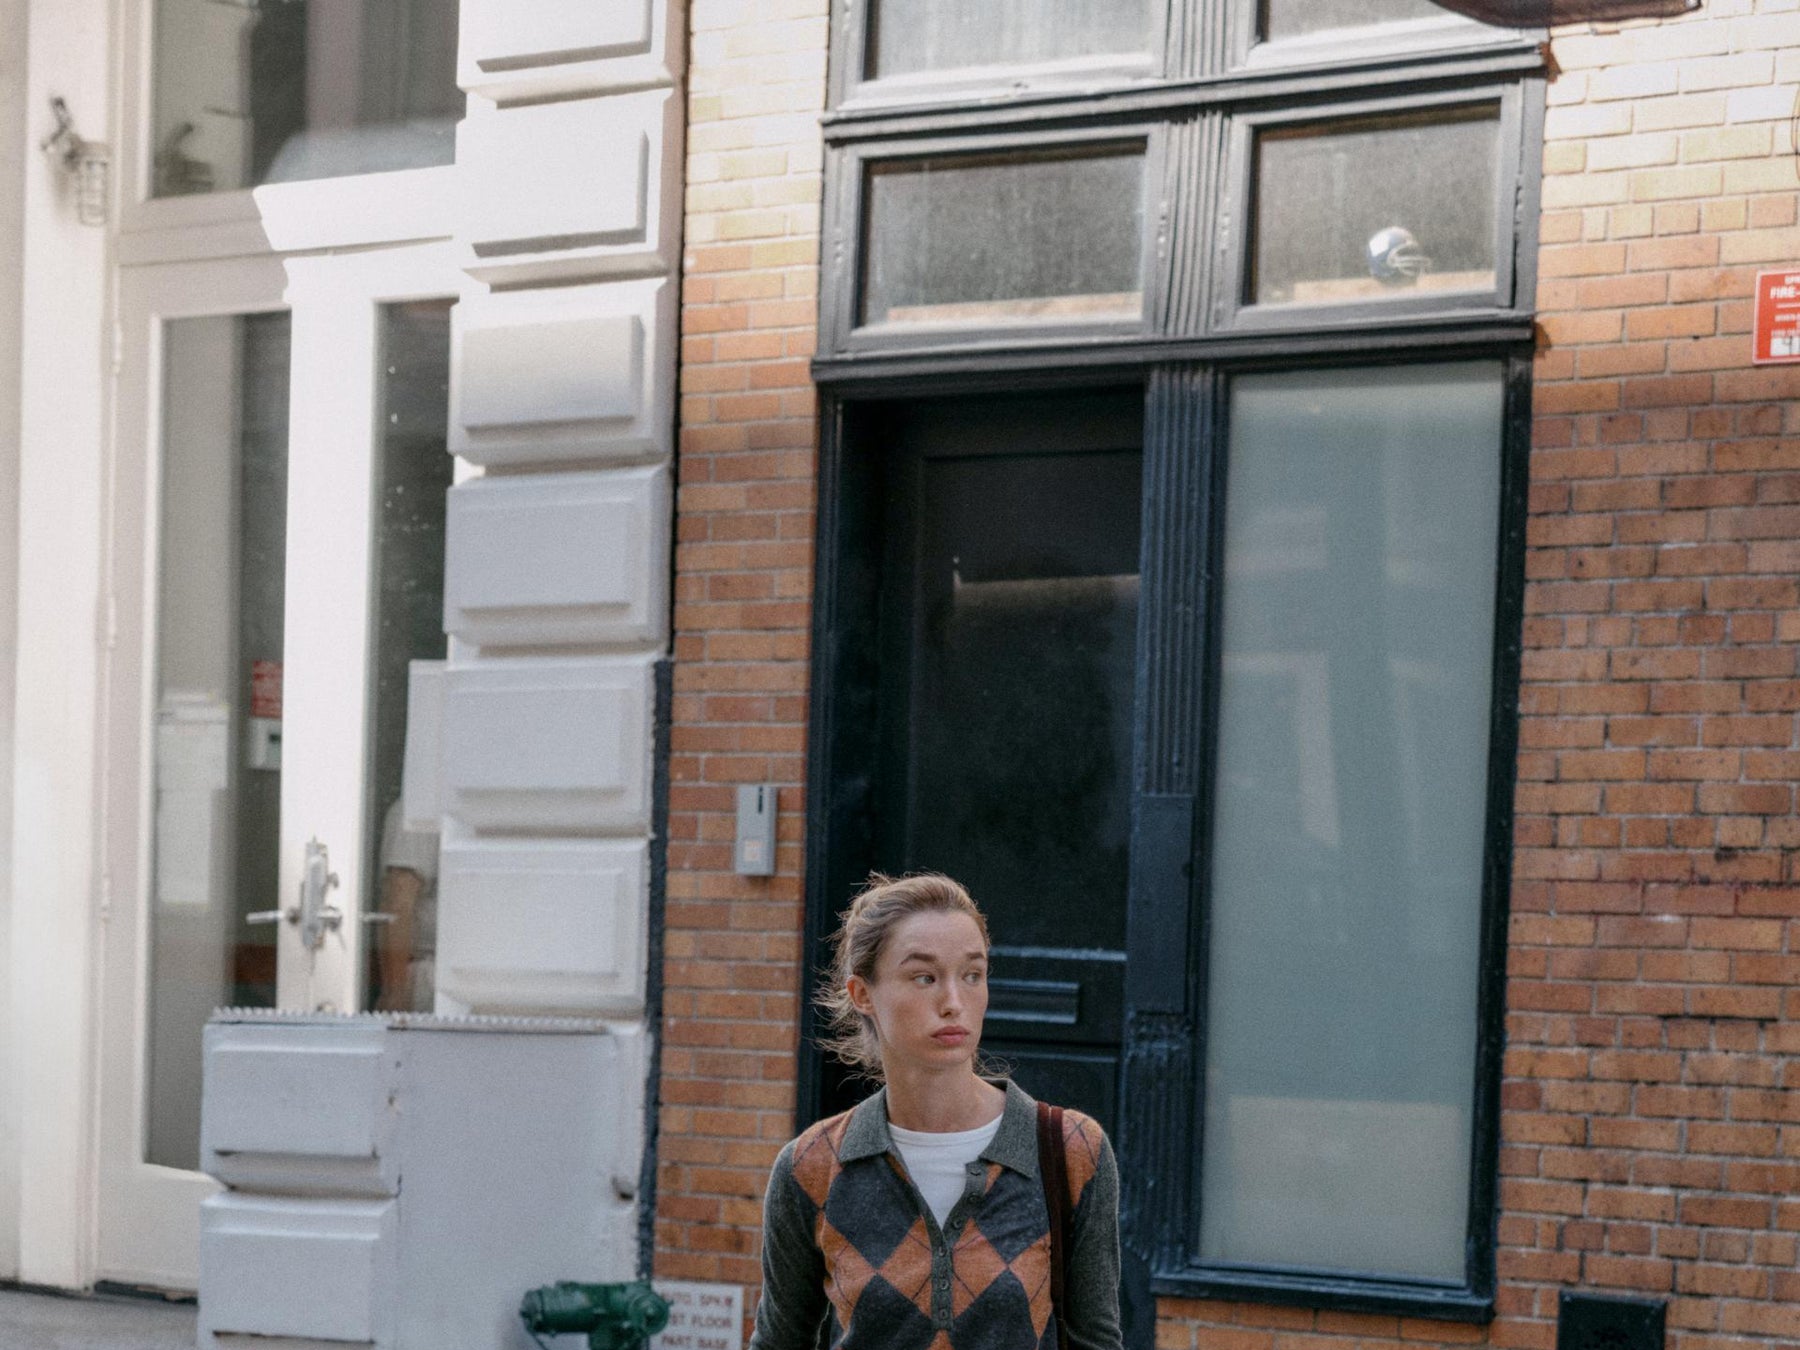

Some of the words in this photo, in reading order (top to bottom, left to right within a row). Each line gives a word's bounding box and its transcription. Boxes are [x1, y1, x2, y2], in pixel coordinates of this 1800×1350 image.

[691, 1314, 732, 1328] FLOOR
[661, 1333, 691, 1347] PART
[698, 1338, 728, 1350] BASE
